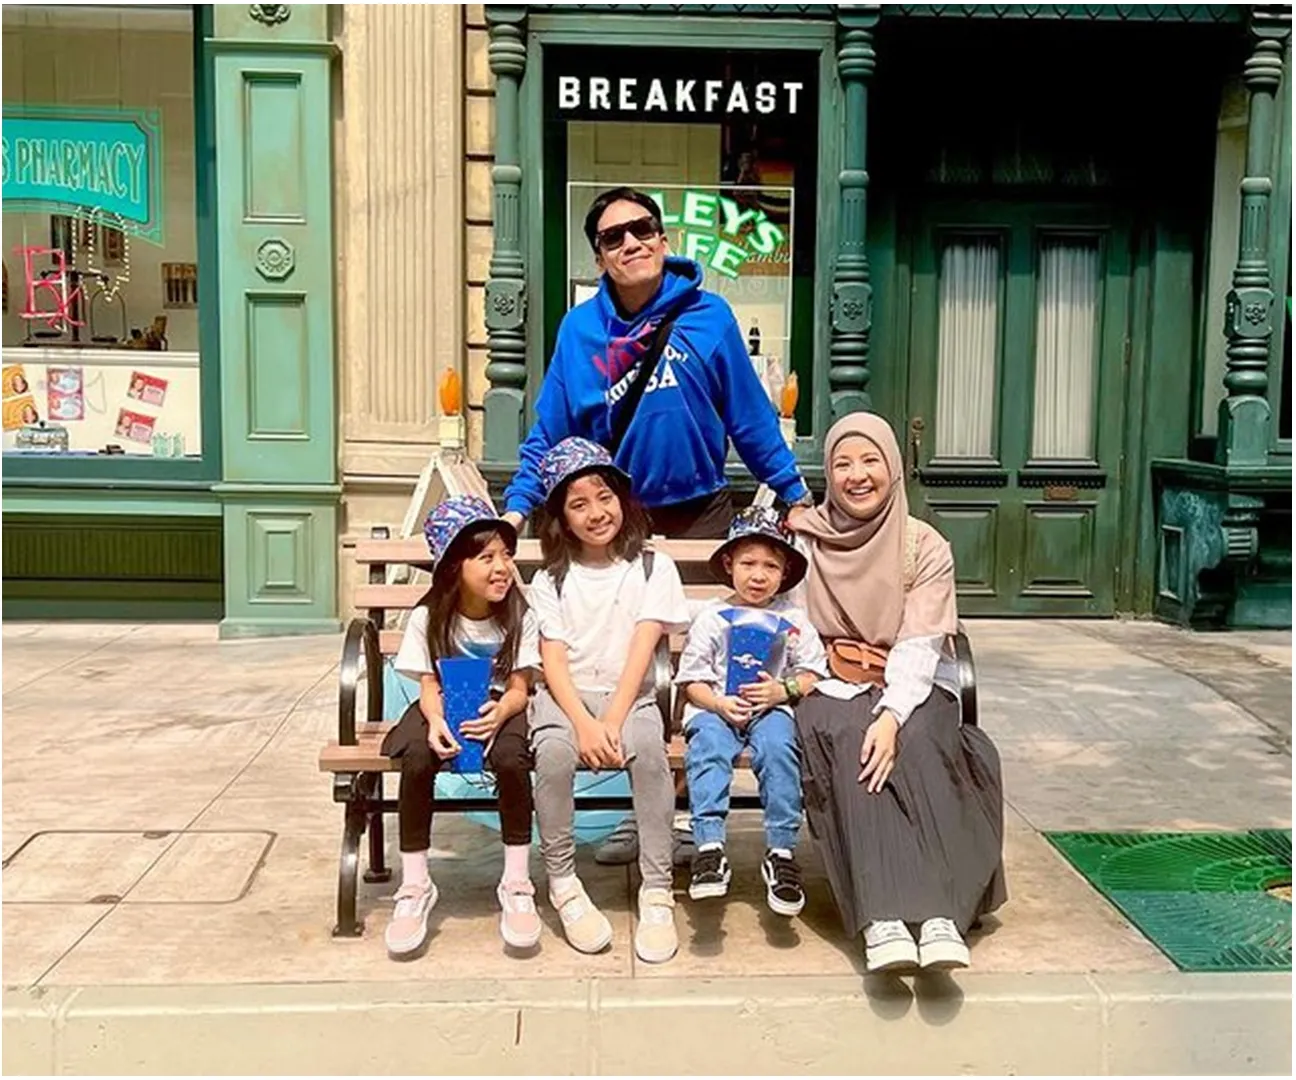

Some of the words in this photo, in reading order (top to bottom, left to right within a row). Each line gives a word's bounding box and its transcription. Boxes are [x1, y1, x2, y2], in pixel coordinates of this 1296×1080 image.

[558, 76, 804, 114] BREAKFAST
[15, 137, 146, 204] PHARMACY
[678, 231, 749, 280] FE
